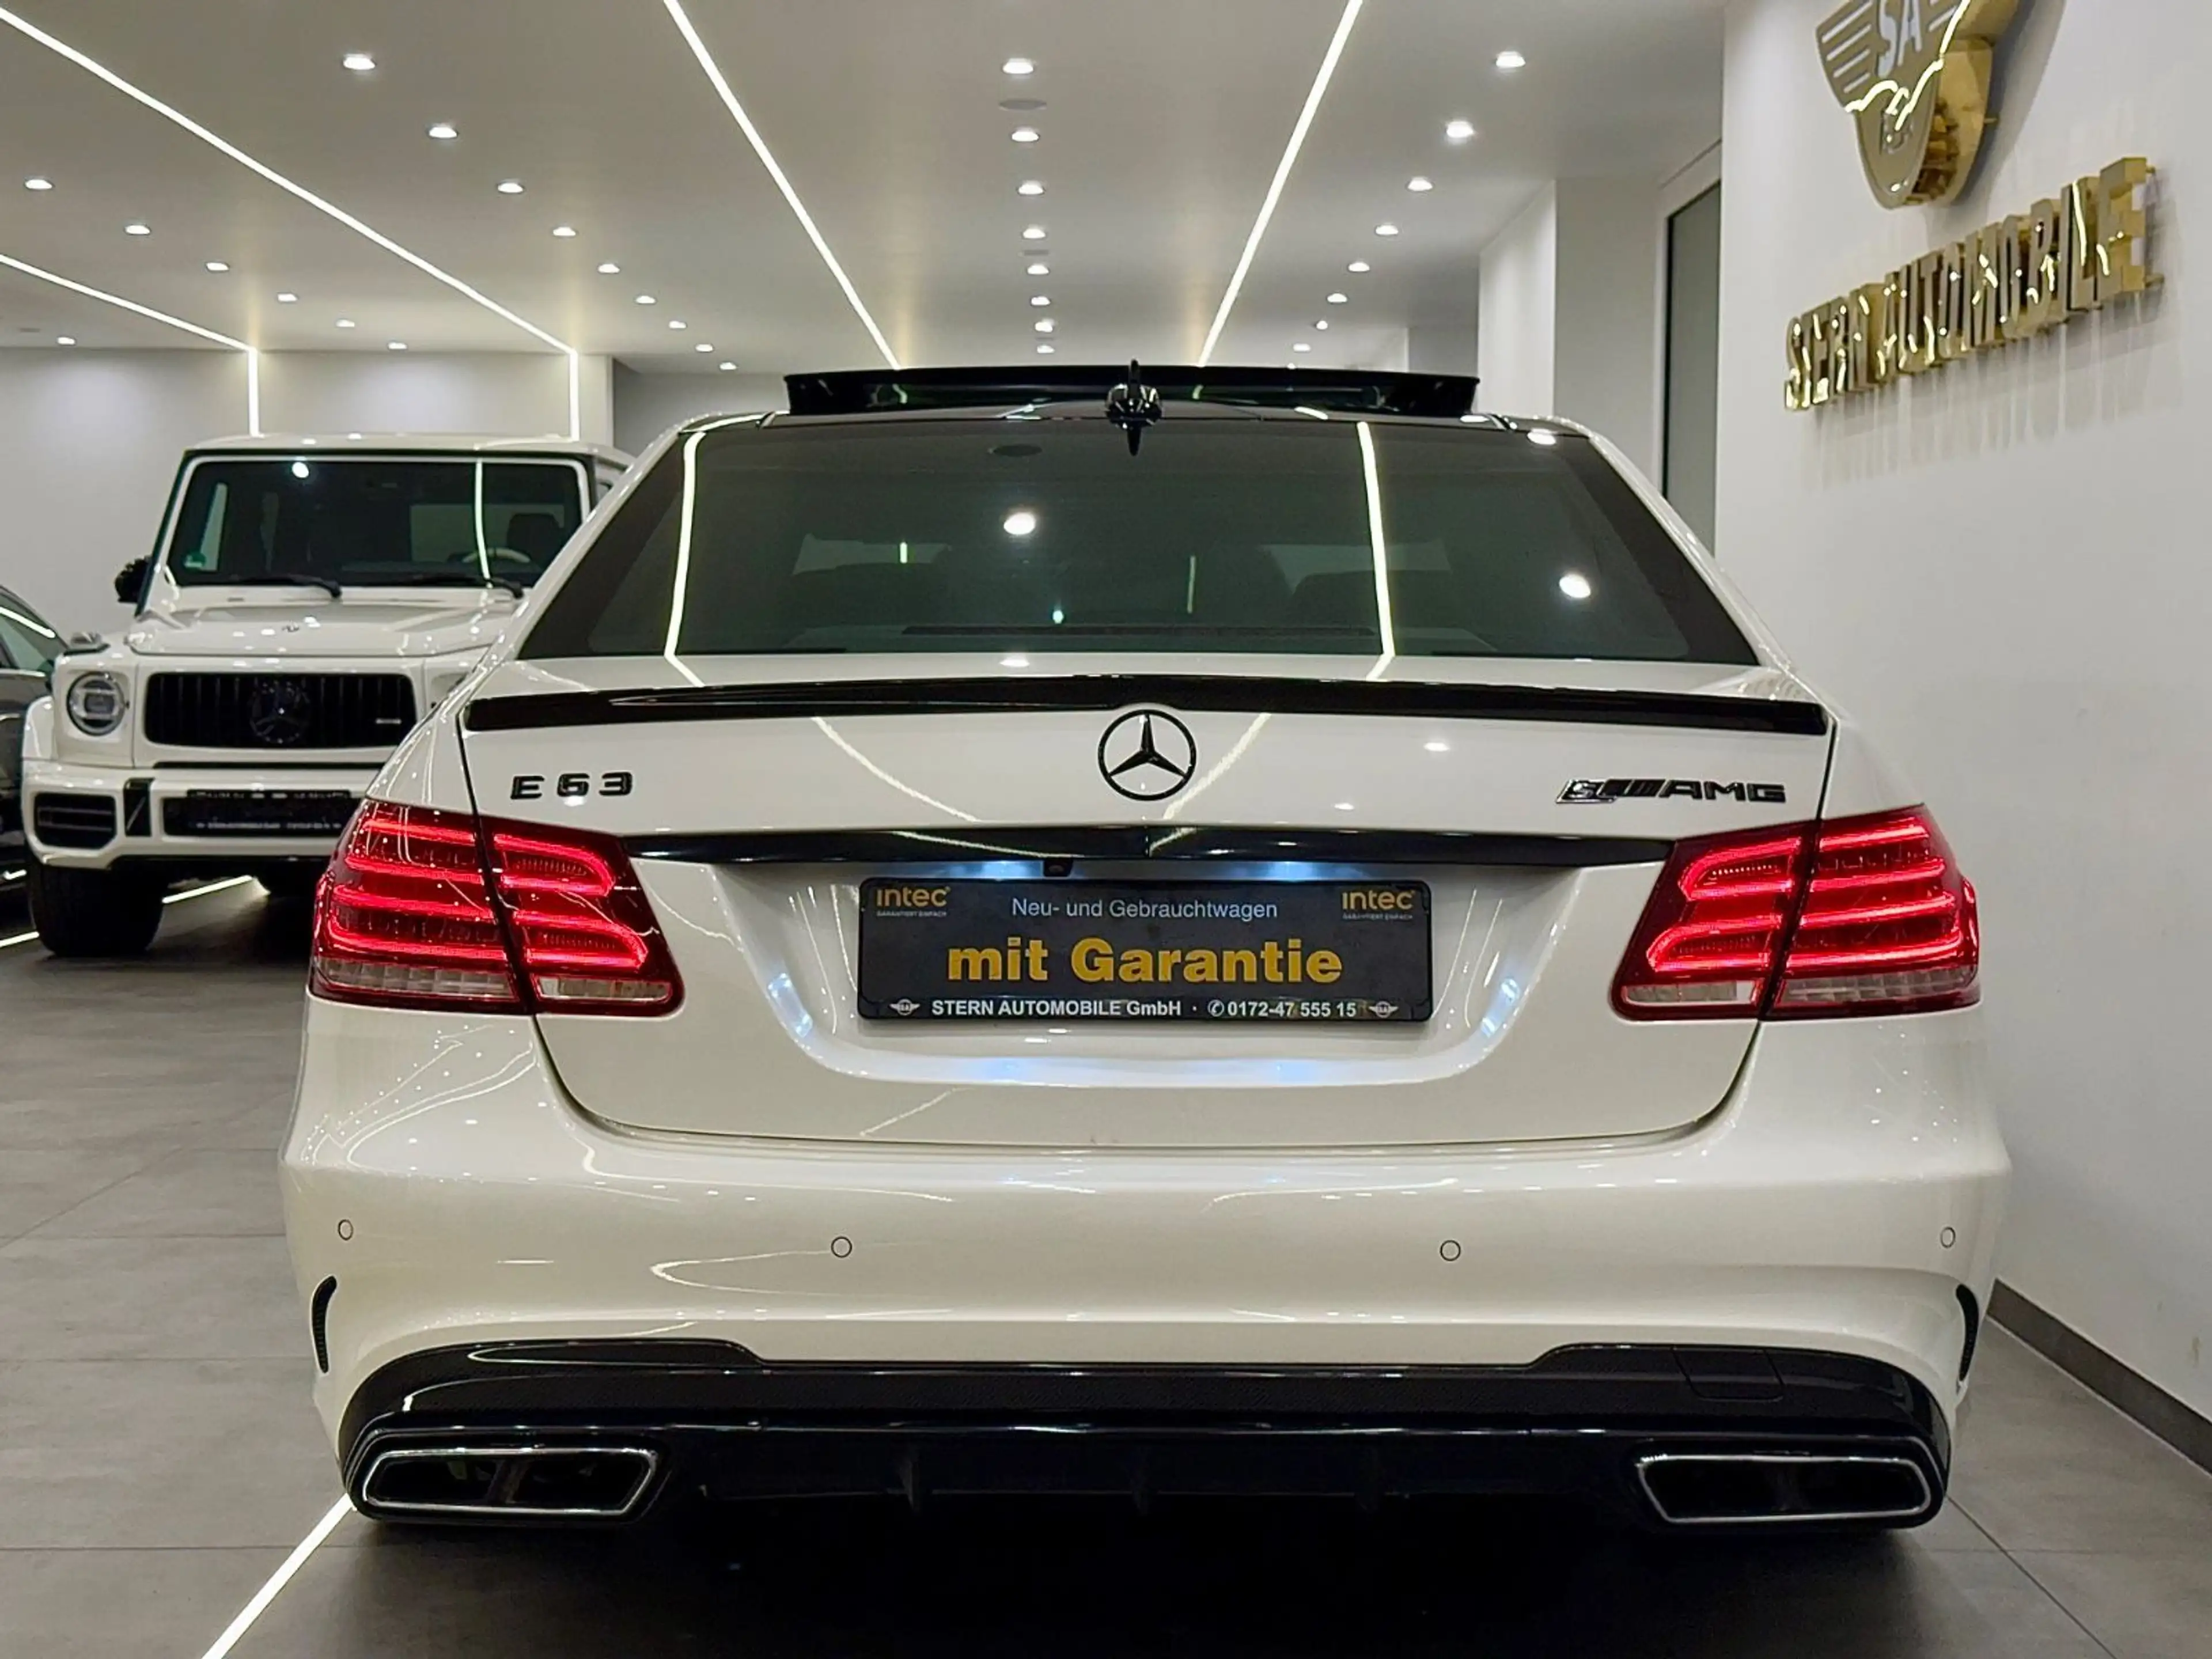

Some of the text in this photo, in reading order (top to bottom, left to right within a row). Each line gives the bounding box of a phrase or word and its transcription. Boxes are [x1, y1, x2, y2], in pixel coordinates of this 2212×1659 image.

[1874, 157, 2149, 380] AUTOMOBILE
[1658, 779, 1786, 802] AMG
[876, 886, 948, 907] intec
[1342, 889, 1414, 910] intec
[1012, 897, 1278, 922] Neu- und Gebrauchtwagen
[947, 936, 1343, 983] mit Garantie
[931, 1000, 1357, 1017] STERN AUTOMOBILE GmbH 0172-47 555 15
